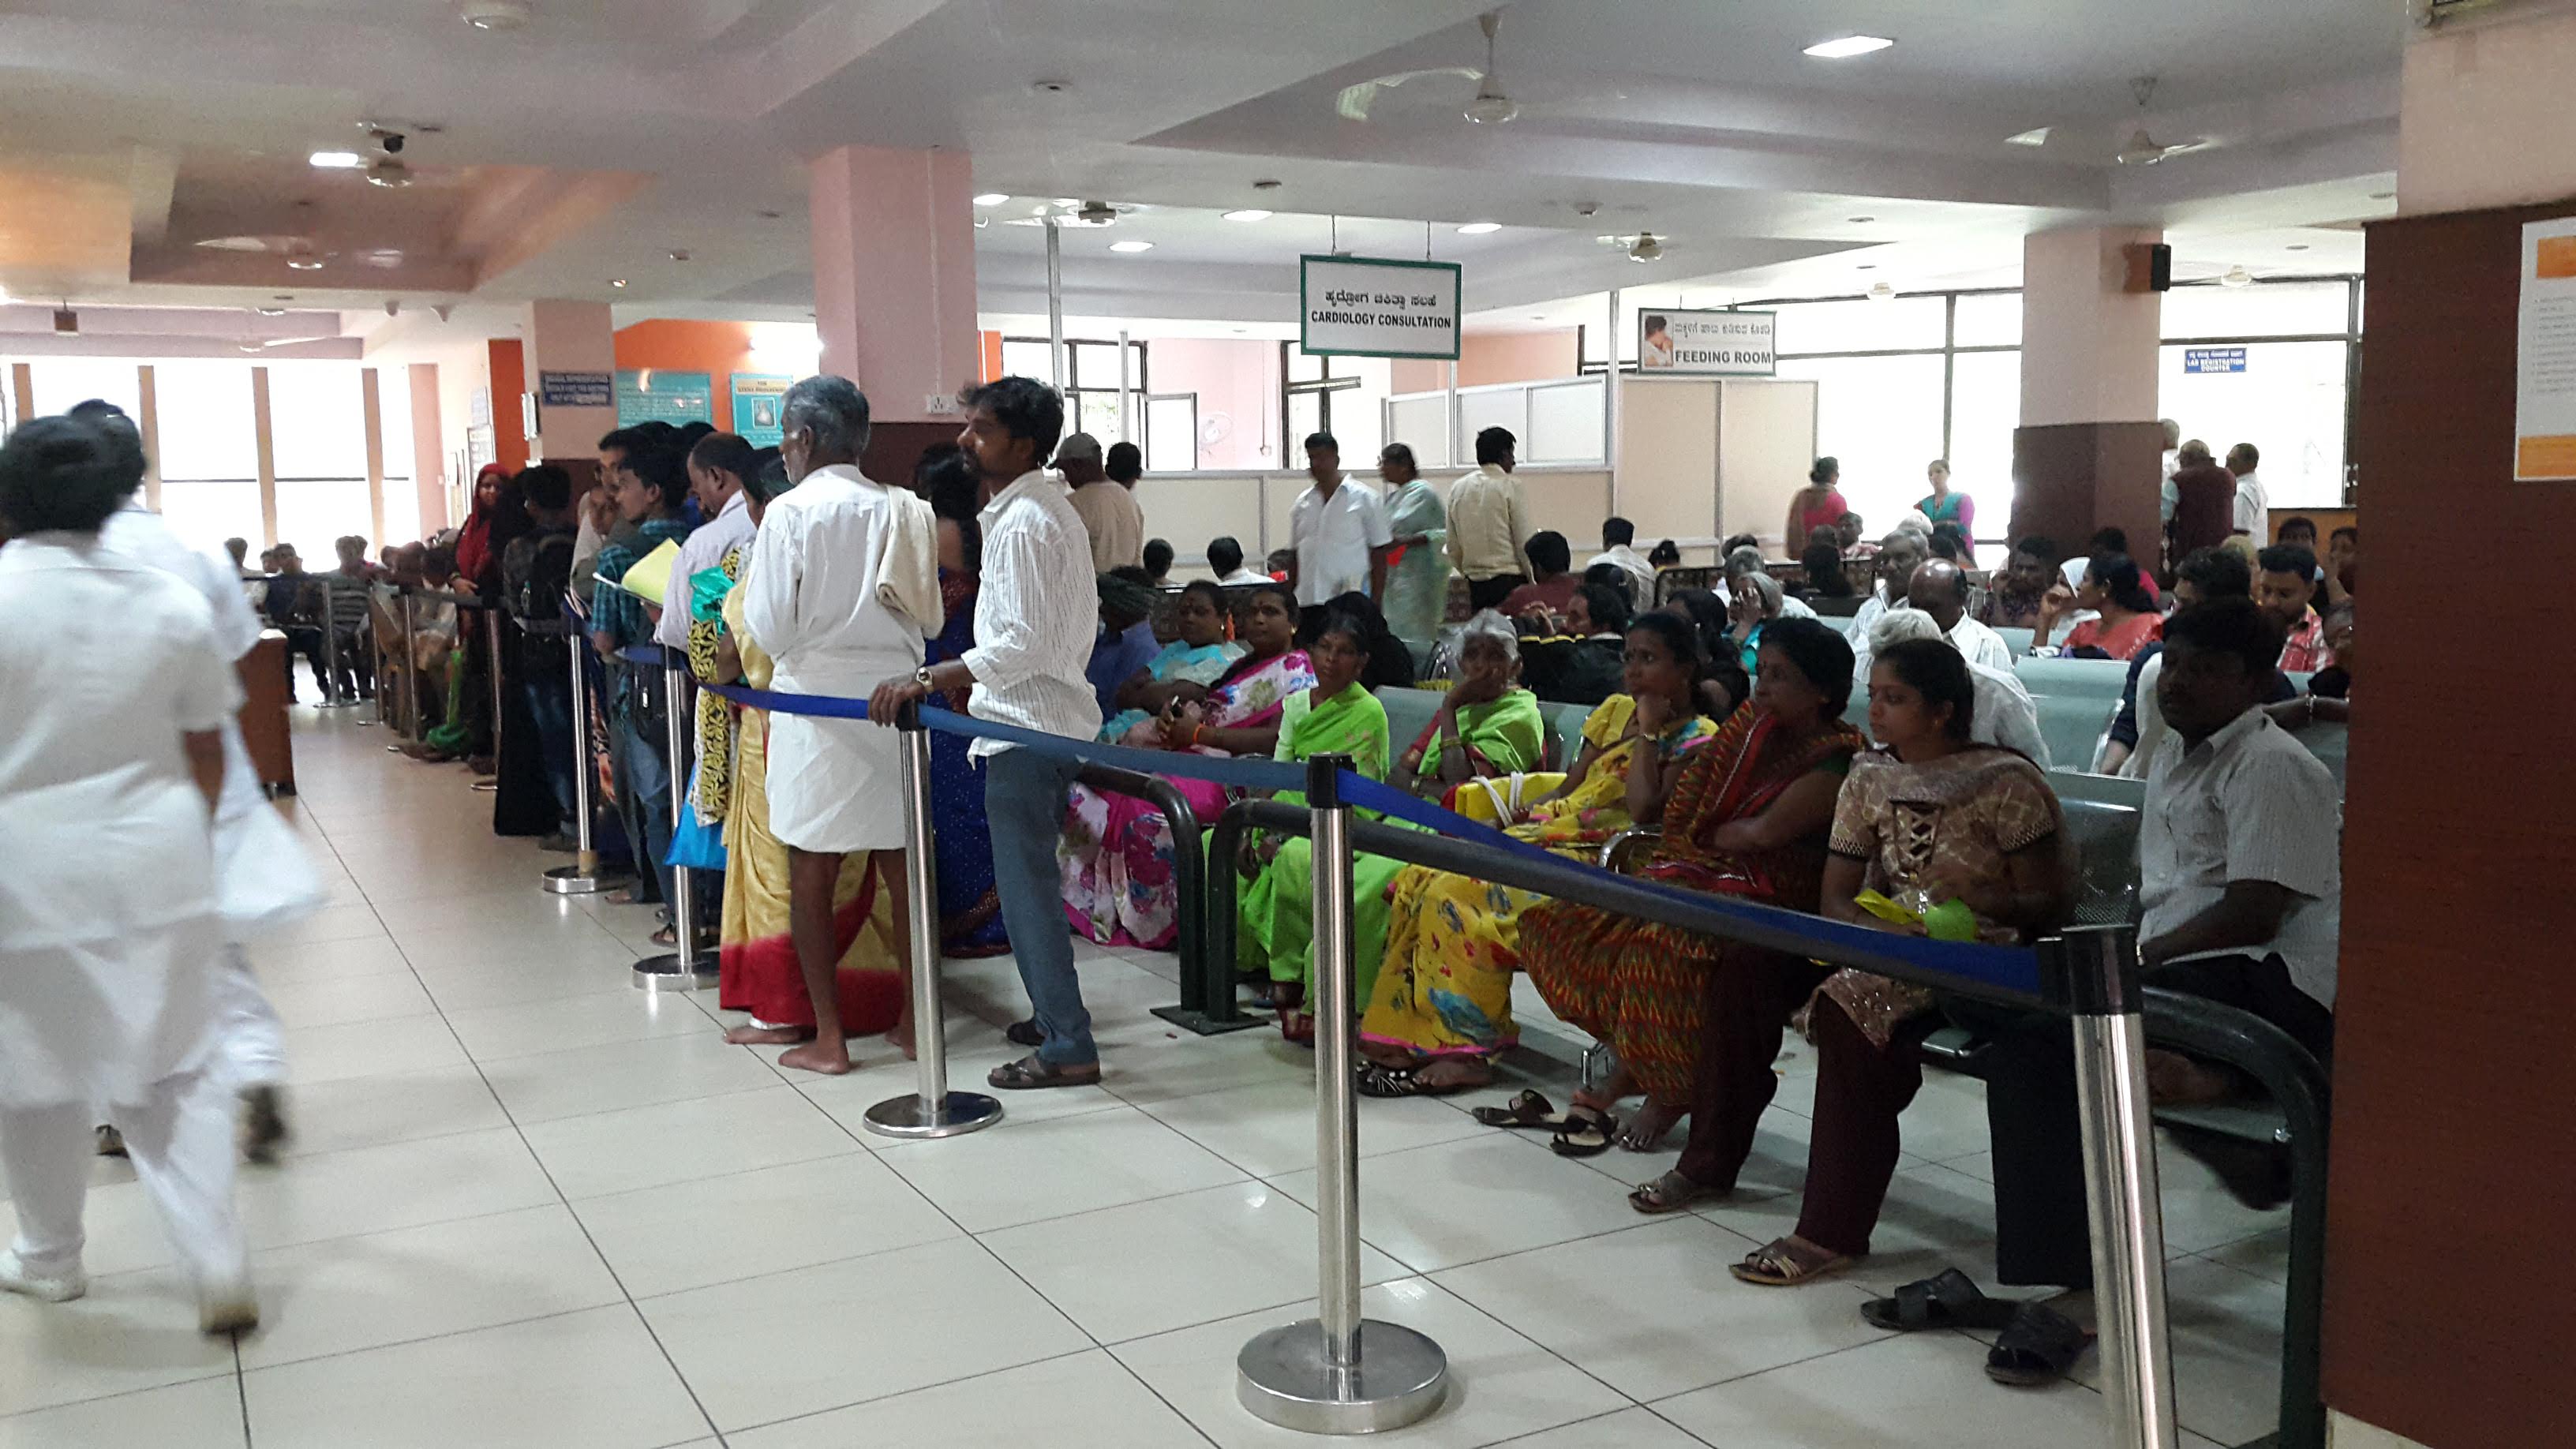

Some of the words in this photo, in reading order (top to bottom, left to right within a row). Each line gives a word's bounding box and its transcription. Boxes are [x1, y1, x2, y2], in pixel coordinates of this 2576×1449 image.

[1410, 294, 1436, 307] ಸಲಹೆ
[1311, 310, 1376, 325] CARDIOLOGY
[1378, 313, 1451, 328] CONSULTATION
[1675, 350, 1731, 363] FEEDING
[1734, 351, 1771, 364] ROOM
[2200, 358, 2245, 366] REGISTRATION
